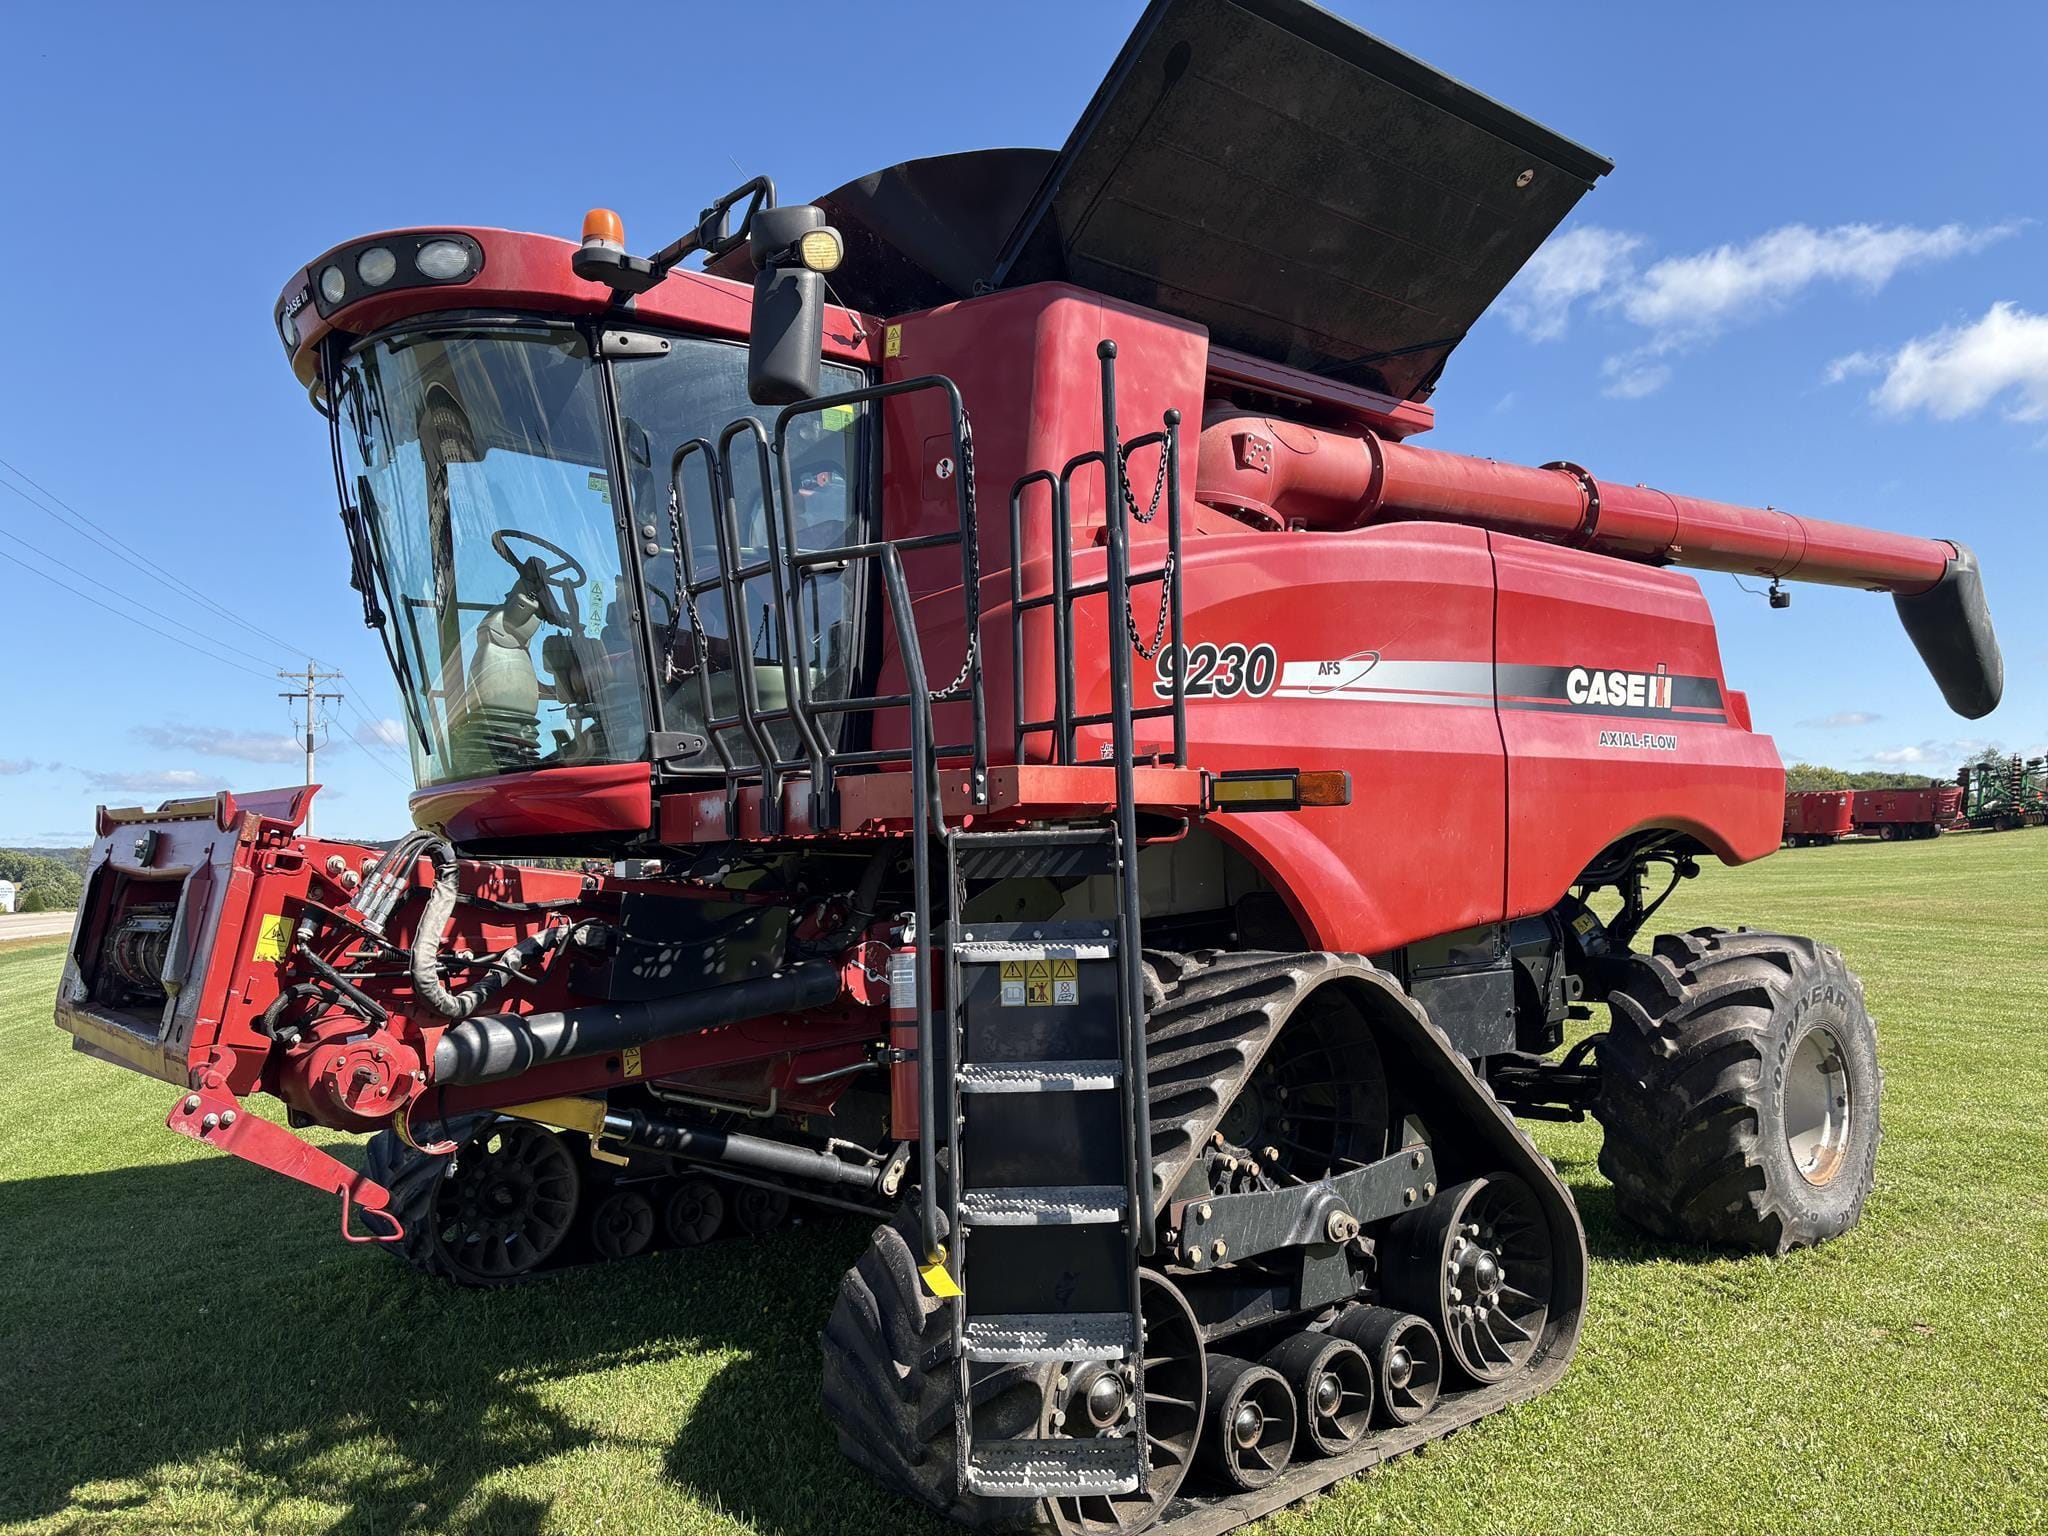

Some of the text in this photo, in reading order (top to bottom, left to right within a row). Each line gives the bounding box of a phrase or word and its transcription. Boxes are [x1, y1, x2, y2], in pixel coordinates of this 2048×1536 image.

[285, 295, 302, 318] CASE
[1154, 643, 1277, 698] 9230
[1317, 661, 1341, 676] AFS
[1599, 731, 1678, 750] AXIAL-FLOW
[1772, 984, 1847, 1118] GOODYEAR
